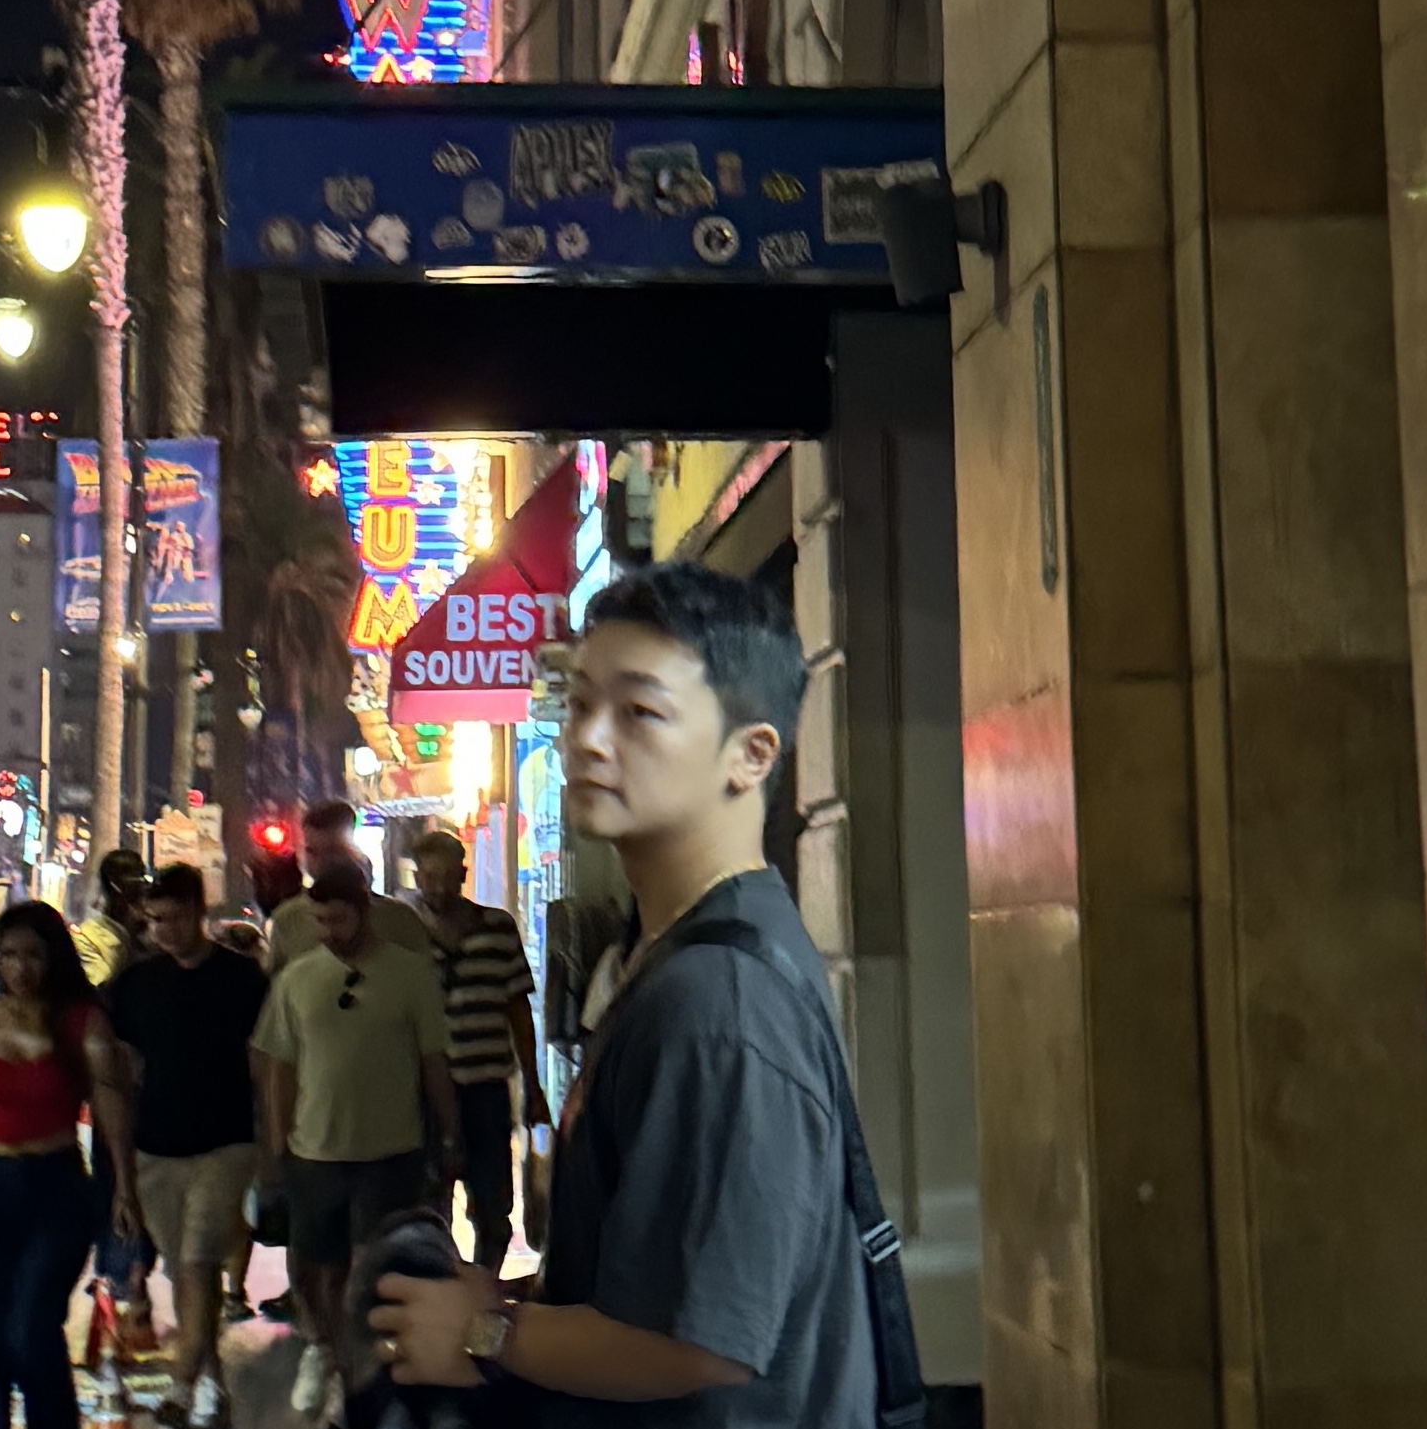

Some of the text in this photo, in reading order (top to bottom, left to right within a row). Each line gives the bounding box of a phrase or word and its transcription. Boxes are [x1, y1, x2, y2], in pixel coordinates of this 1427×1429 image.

[348, 440, 420, 648] EUM
[446, 593, 566, 642] BEST
[404, 650, 540, 686] SOUVEN
